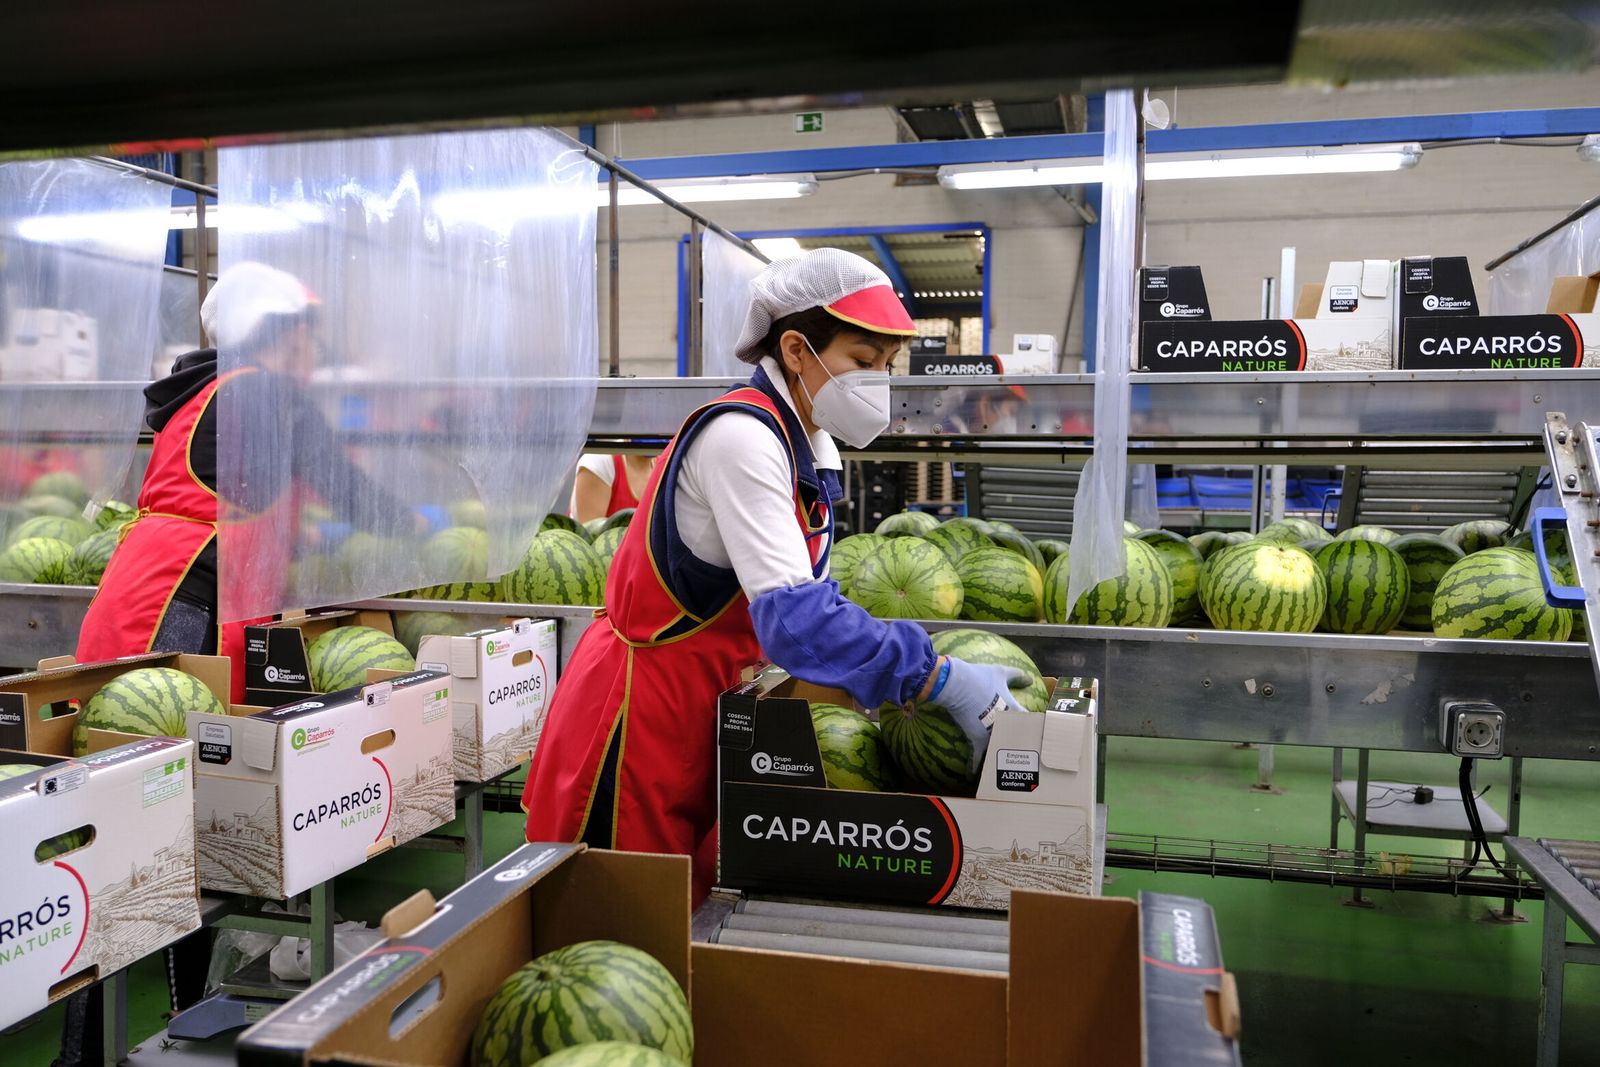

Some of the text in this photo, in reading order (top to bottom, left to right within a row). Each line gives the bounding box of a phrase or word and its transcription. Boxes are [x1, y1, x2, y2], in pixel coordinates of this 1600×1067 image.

[1440, 299, 1471, 308] Caparrós
[1175, 307, 1204, 315] Caparrós
[1157, 335, 1287, 358] CAPARRÓS
[1419, 331, 1562, 356] CAPARRÓS
[925, 362, 993, 375] CAPARRÓS
[1222, 361, 1287, 371] NATURE
[1491, 358, 1561, 368] NATURE
[489, 674, 541, 705] CAPARRÓS
[516, 692, 541, 708] NATURE
[727, 712, 752, 720] COSECHA
[307, 726, 320, 734] Grupo
[307, 728, 335, 742] Caparrós
[202, 744, 228, 754] AENOR
[1006, 752, 1030, 760] Empresa
[773, 761, 815, 772] Caparrós
[1001, 771, 1034, 781] AENOR
[293, 782, 381, 831] CAPARRÓS
[341, 803, 382, 829] NATURE
[742, 814, 933, 853] CAPARRÓS
[838, 853, 932, 875] NATURE
[0, 922, 72, 965] NATURE
